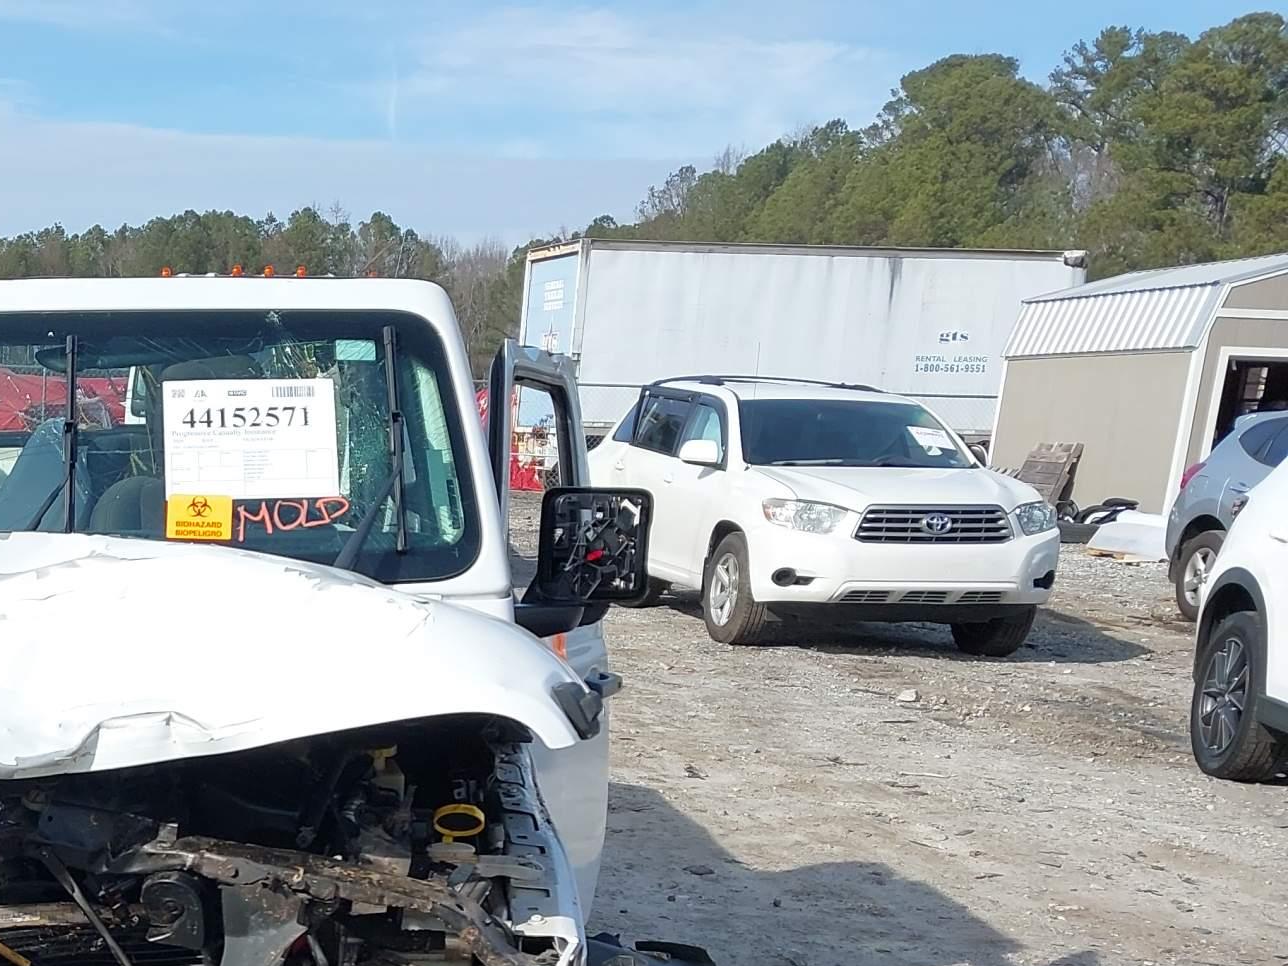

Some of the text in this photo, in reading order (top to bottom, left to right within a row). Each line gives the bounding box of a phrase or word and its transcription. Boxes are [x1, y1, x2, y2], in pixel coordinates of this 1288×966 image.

[939, 332, 969, 344] gts
[915, 355, 988, 363] RENTAL LEASING
[915, 364, 986, 373] 1-800-561-9551
[182, 407, 310, 428] 44152571
[237, 497, 349, 541] MOLD
